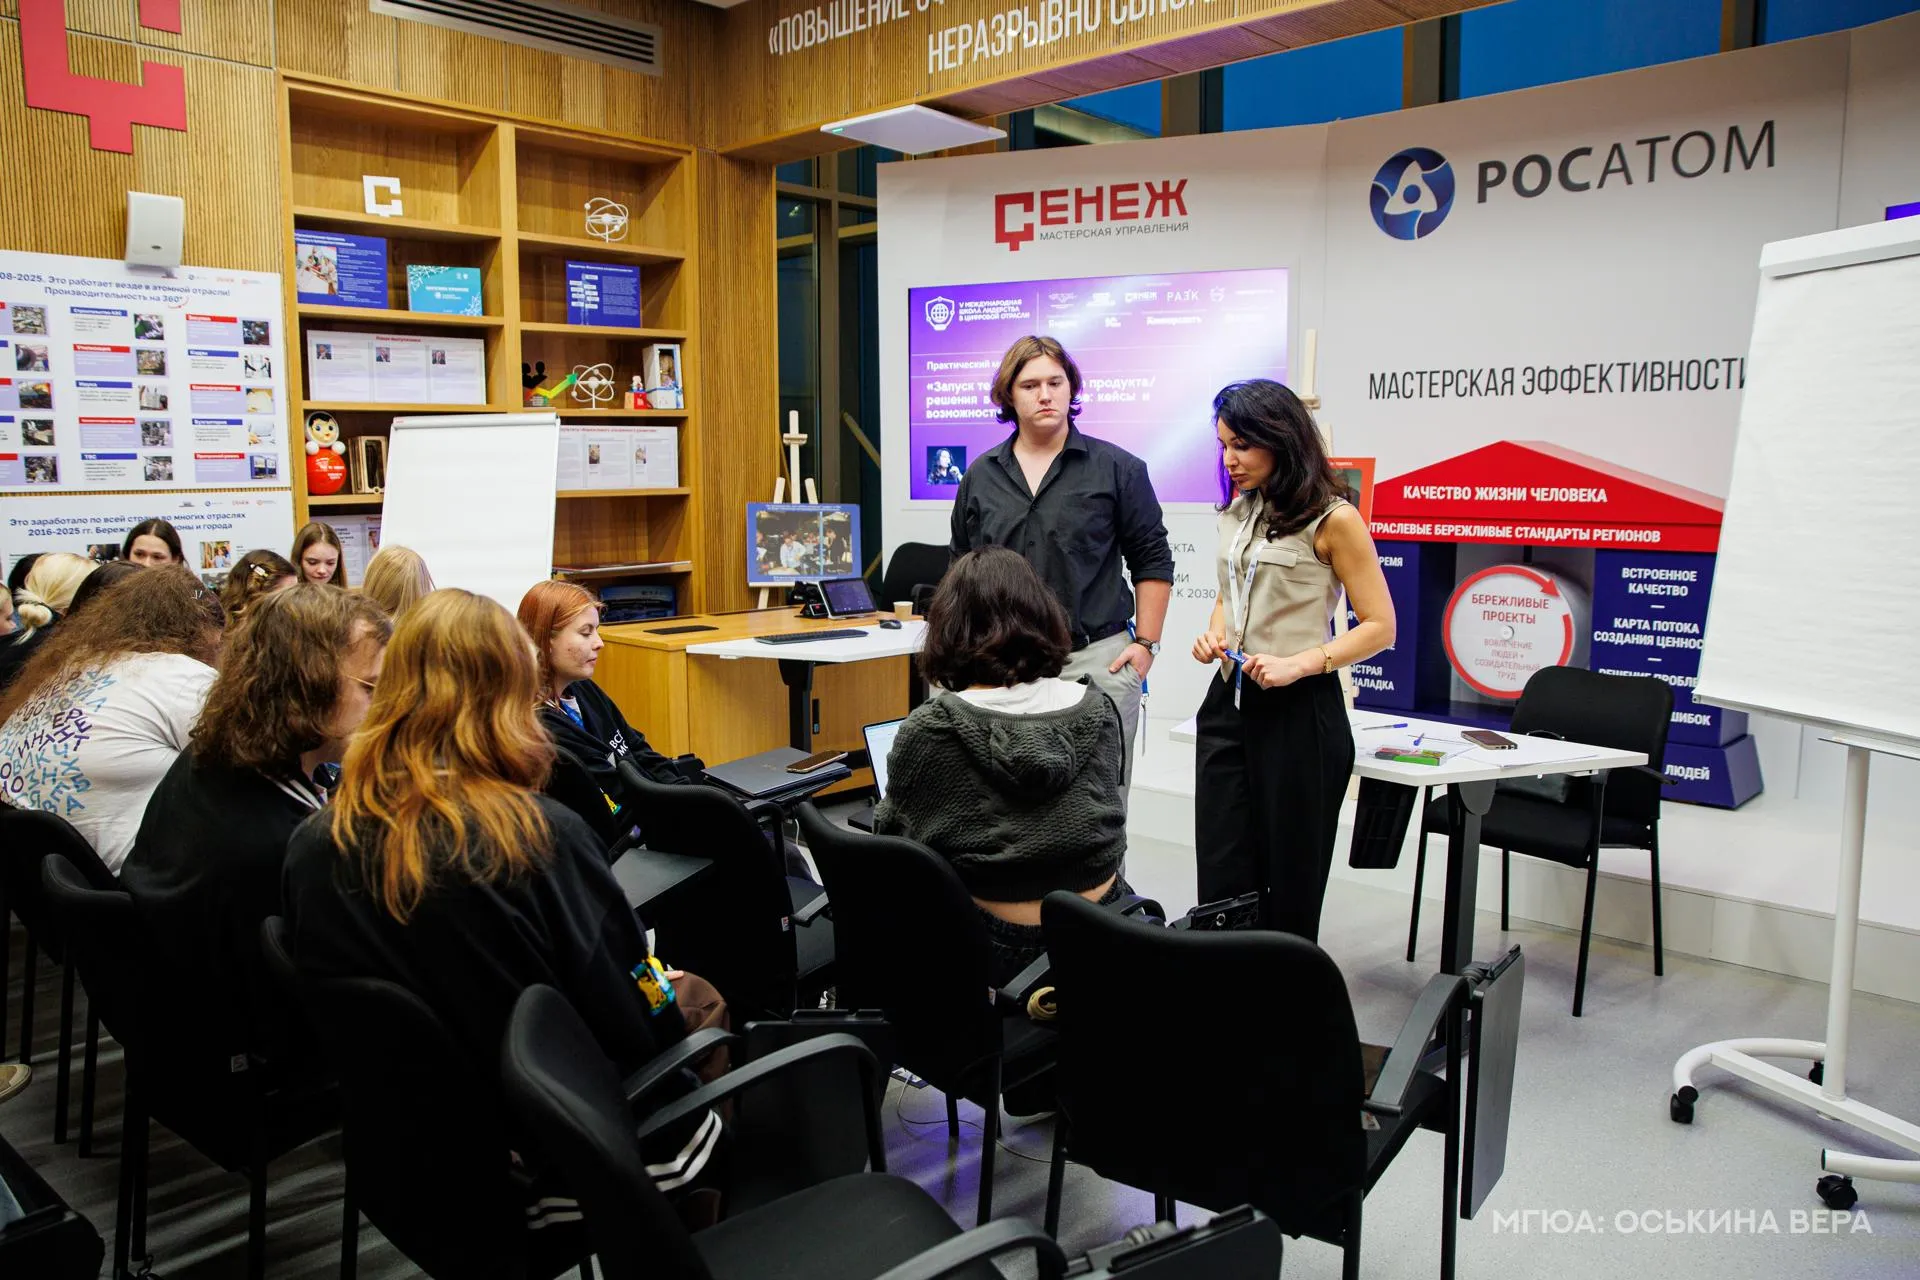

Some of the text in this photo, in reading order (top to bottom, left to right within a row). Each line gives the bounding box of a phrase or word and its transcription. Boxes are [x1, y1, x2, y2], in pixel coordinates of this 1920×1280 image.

[1477, 119, 1775, 203] РОСАТОМ
[994, 178, 1189, 252] СЕНЕЖ
[1040, 222, 1189, 241] МАСТЕРСКАЯ УПРАВЛЕНИЯ
[44, 286, 148, 301] Производительность
[48, 275, 67, 284] Это
[69, 278, 113, 288] работает
[115, 282, 143, 291] везде
[152, 284, 191, 294] атомной
[192, 287, 231, 298] отрасли!
[926, 360, 990, 372] Практический
[926, 380, 975, 394] «Запуск
[1089, 375, 1156, 392] продукта/
[1369, 366, 1515, 400] МАСТЕРСКАЯ
[925, 395, 977, 408] решения
[1097, 390, 1136, 402] кейсы
[1403, 485, 1608, 503] КАЧЕСТВО ЖИЗНИ ЧЕЛОВЕКА
[10, 518, 29, 526] Это
[31, 516, 88, 527] заработало
[103, 515, 126, 523] всей
[174, 513, 205, 521] многих
[207, 512, 246, 522] отраслях
[28, 527, 80, 536] 2016-2025
[203, 523, 233, 532] города
[1369, 521, 1661, 543] ТРАСЛЕВЫЕ БЕРЕЖЛИВЫЕ СТАНДАРТЫ РЕГИОНОВ
[1378, 556, 1403, 567] РЕМЯ
[1621, 567, 1698, 582] ВСТРОЕННОЕ
[1187, 588, 1217, 599] 2030
[1628, 583, 1689, 597] КАЧЕСТВО
[1471, 593, 1549, 609] БЕРЕЖЛИВЫЕ
[1482, 610, 1536, 624] ПРОЕКТЫ
[1613, 617, 1700, 634] КАРТА ПОТОКА
[1484, 638, 1533, 650] ВОВЛЕЧЕНИЕ
[1593, 631, 1705, 650] СОЗДАНИЯ ЦЕННОС
[1491, 649, 1519, 660] ЛЮДЕЙ
[1497, 671, 1517, 681] ТРУД
[1351, 677, 1395, 691] НАЛАДКА
[1670, 711, 1711, 726] ШИБОК
[1664, 764, 1711, 780] ЛЮДЕЙ
